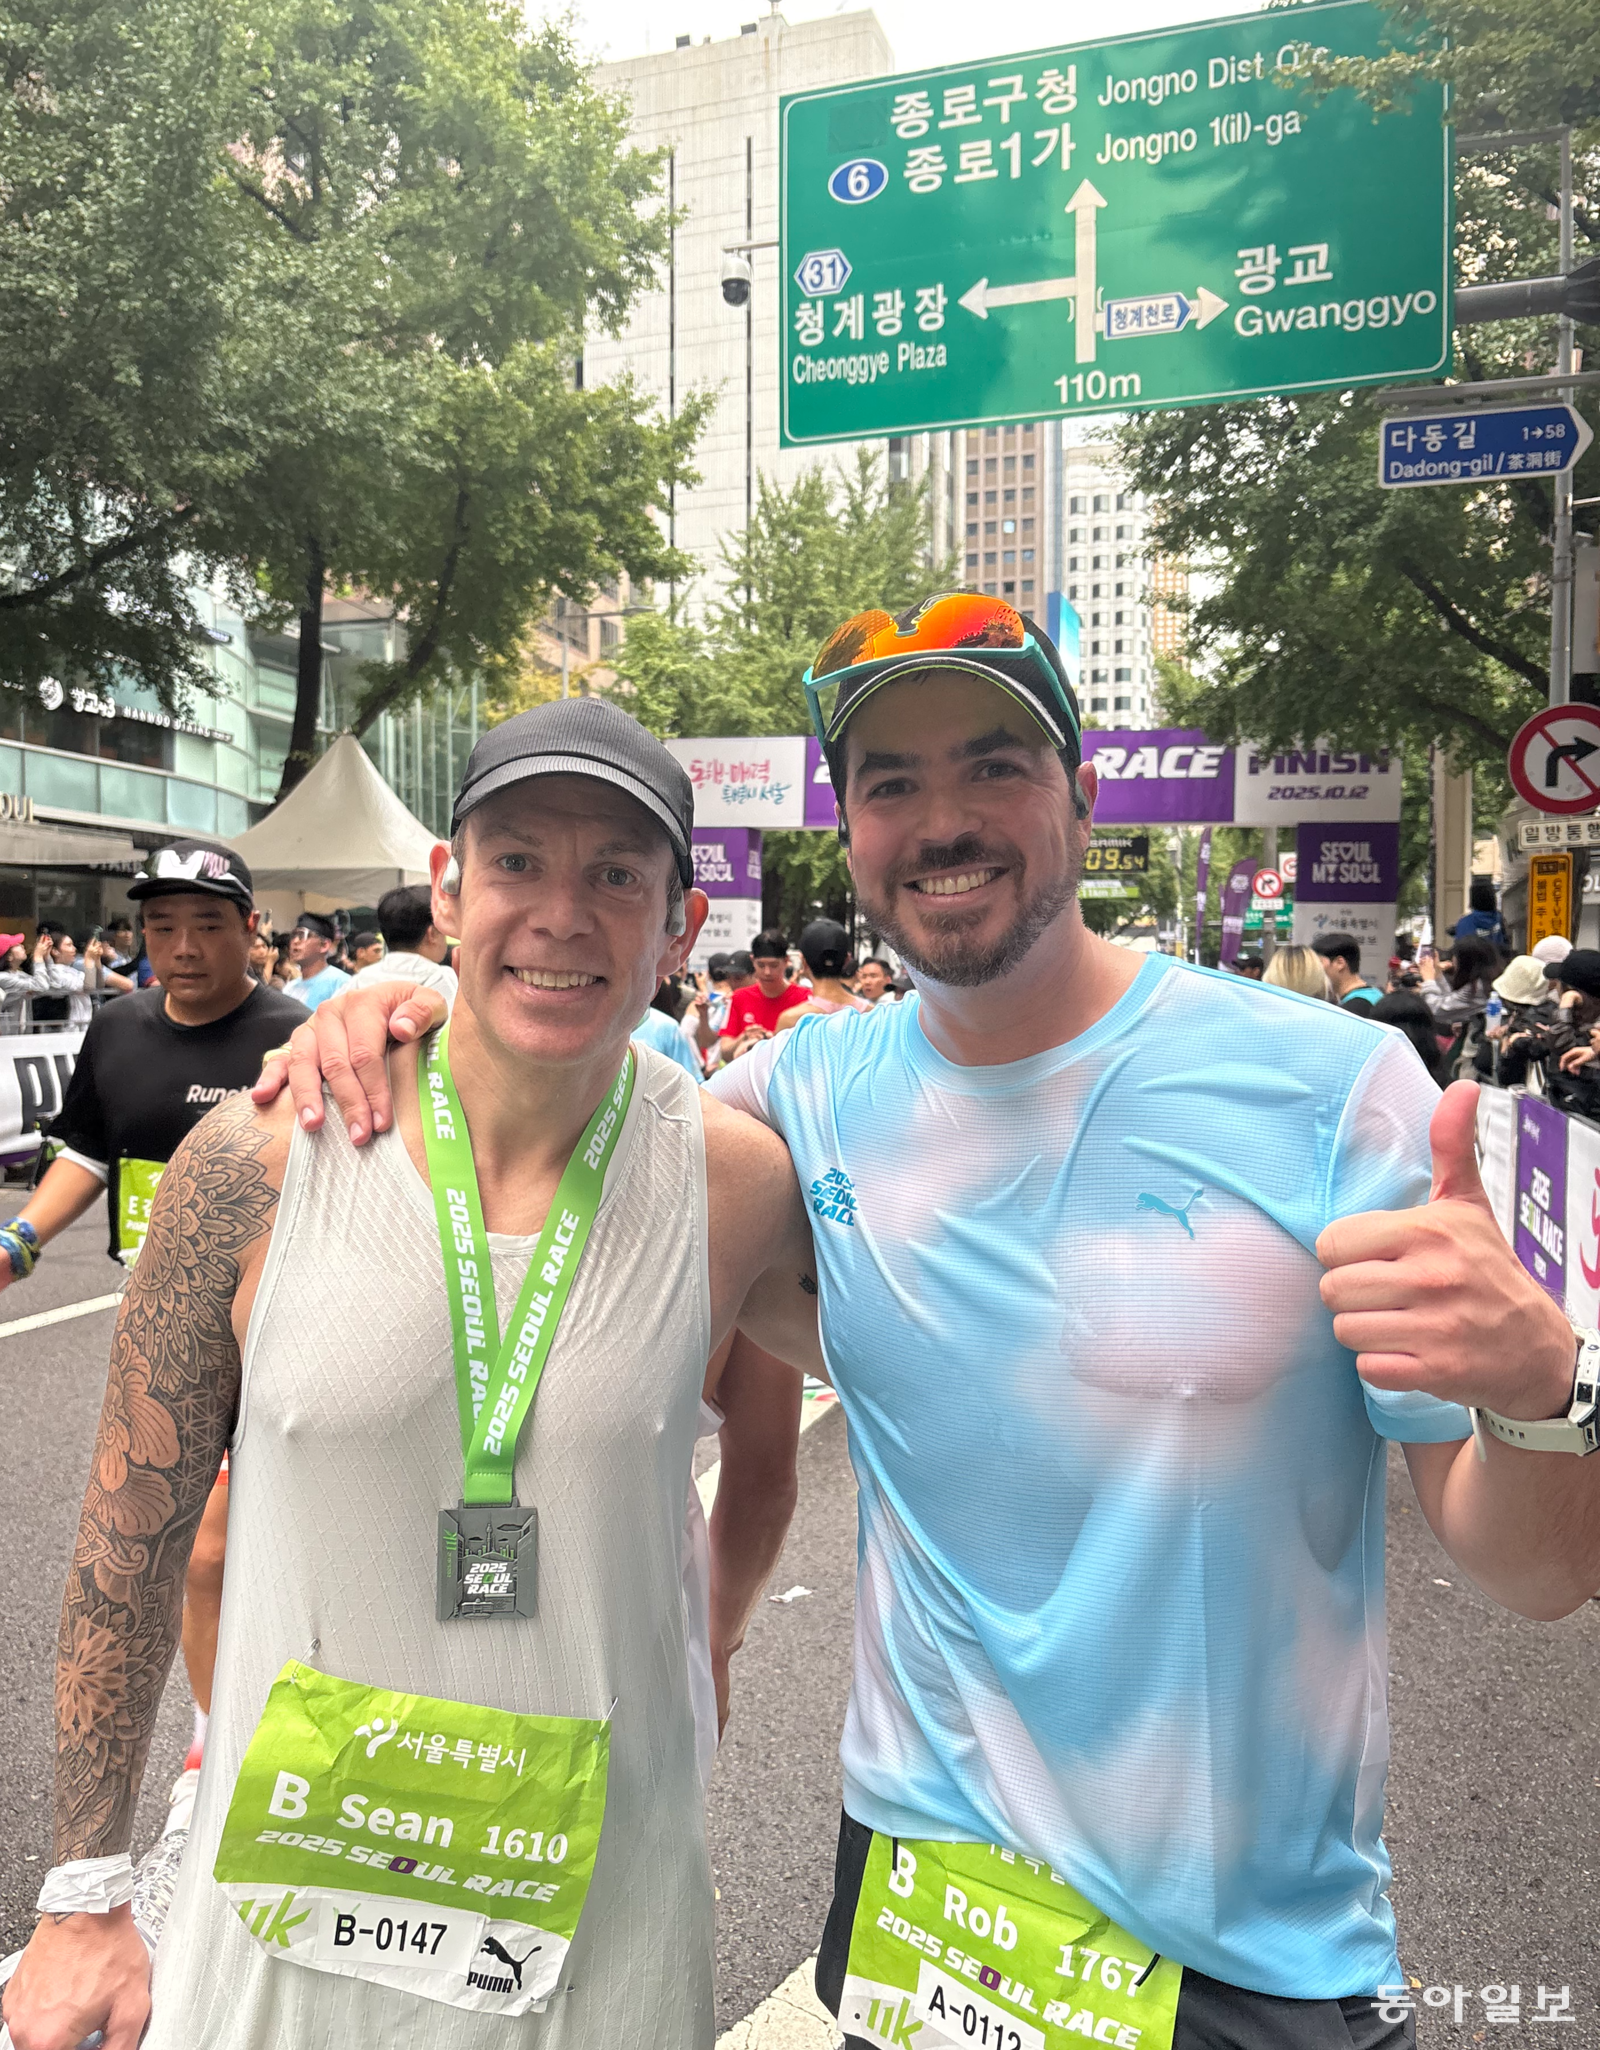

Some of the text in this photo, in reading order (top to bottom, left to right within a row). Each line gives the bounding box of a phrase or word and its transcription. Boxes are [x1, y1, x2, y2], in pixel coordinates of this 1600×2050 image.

[890, 64, 1079, 140] 종로구청
[1097, 70, 1197, 107] Jongno
[1208, 52, 1264, 87] Dist
[1096, 109, 1302, 165] Jongno 1(il)-ga
[847, 165, 870, 197] 6
[903, 129, 1076, 194] 종로1가
[807, 256, 839, 288] 31
[1235, 242, 1333, 296] 광교
[794, 284, 947, 347] 청계광장
[1114, 303, 1176, 330] 청계천로
[1234, 288, 1437, 338] Gwanggyo
[793, 340, 947, 386] Cheonggye Plaza
[1054, 368, 1142, 404] 110m
[1390, 420, 1476, 453] 다동길
[1092, 744, 1226, 779] RACE
[1268, 785, 1369, 800] 2025.10.12
[692, 844, 727, 862] EOUL
[1320, 842, 1372, 862] SEOUL
[1339, 864, 1381, 883] SOUL
[427, 1071, 456, 1141] RACE
[582, 1105, 618, 1171] 2025
[128, 1195, 139, 1215] E
[810, 1180, 858, 1211] SEOUL
[813, 1197, 855, 1226] RACE
[1542, 1213, 1563, 1267] RACE
[445, 1187, 490, 1425] 2025 SEOUL RA
[484, 1209, 580, 1456] 2025 SEOUL RACE
[464, 1573, 513, 1584] SEOUL
[467, 1583, 509, 1594] RACE
[470, 1563, 507, 1573] 2025
[397, 1732, 527, 1777] 서울특별시
[268, 1770, 568, 1864] B Sean 1610
[255, 1830, 560, 1902] 2025 SEOUL RACE
[334, 1914, 448, 1955] B-0147
[888, 1844, 1147, 1997] B Rob 1767
[466, 1972, 514, 1994] PUMA
[876, 1907, 1142, 2050] 2025 SEOUL RACE
[928, 1985, 1021, 2050] A-0112
